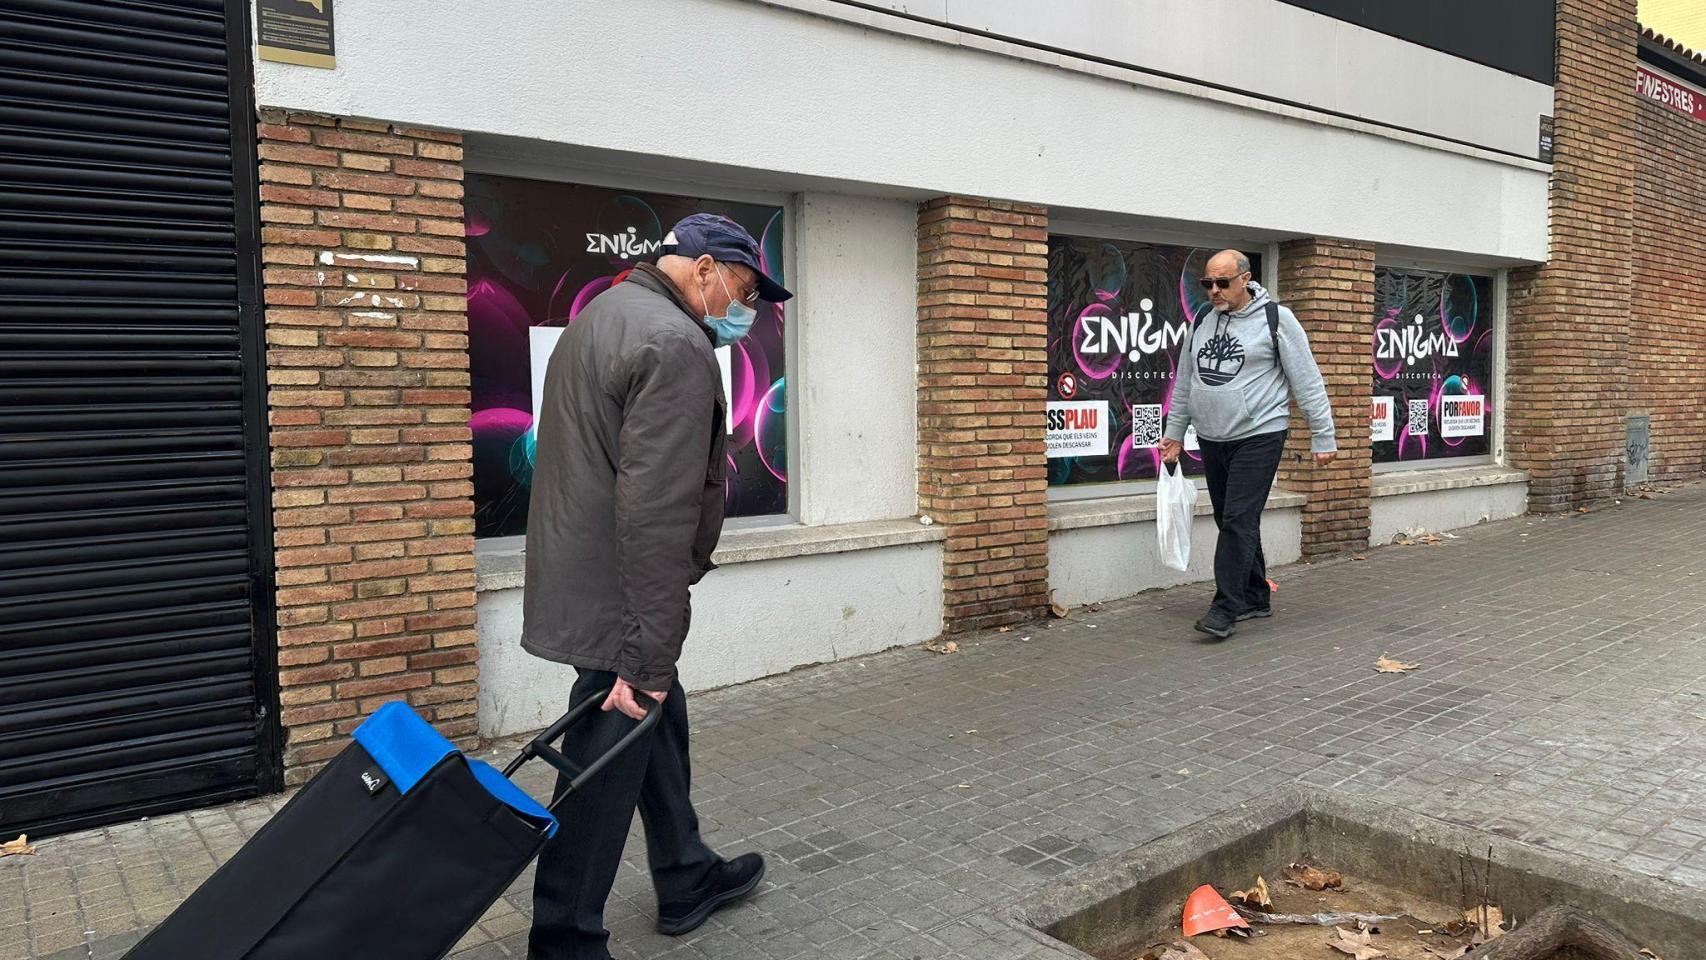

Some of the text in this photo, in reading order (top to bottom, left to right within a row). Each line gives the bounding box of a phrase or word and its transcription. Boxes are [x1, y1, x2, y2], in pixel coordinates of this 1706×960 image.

[1635, 71, 1694, 114] FINESTRES
[586, 226, 661, 259] ENIGM
[1080, 298, 1188, 362] ENIGM
[1376, 314, 1459, 366] ENIGMA
[1112, 371, 1173, 379] DISCOTEC
[1047, 409, 1097, 431] SSPLAU
